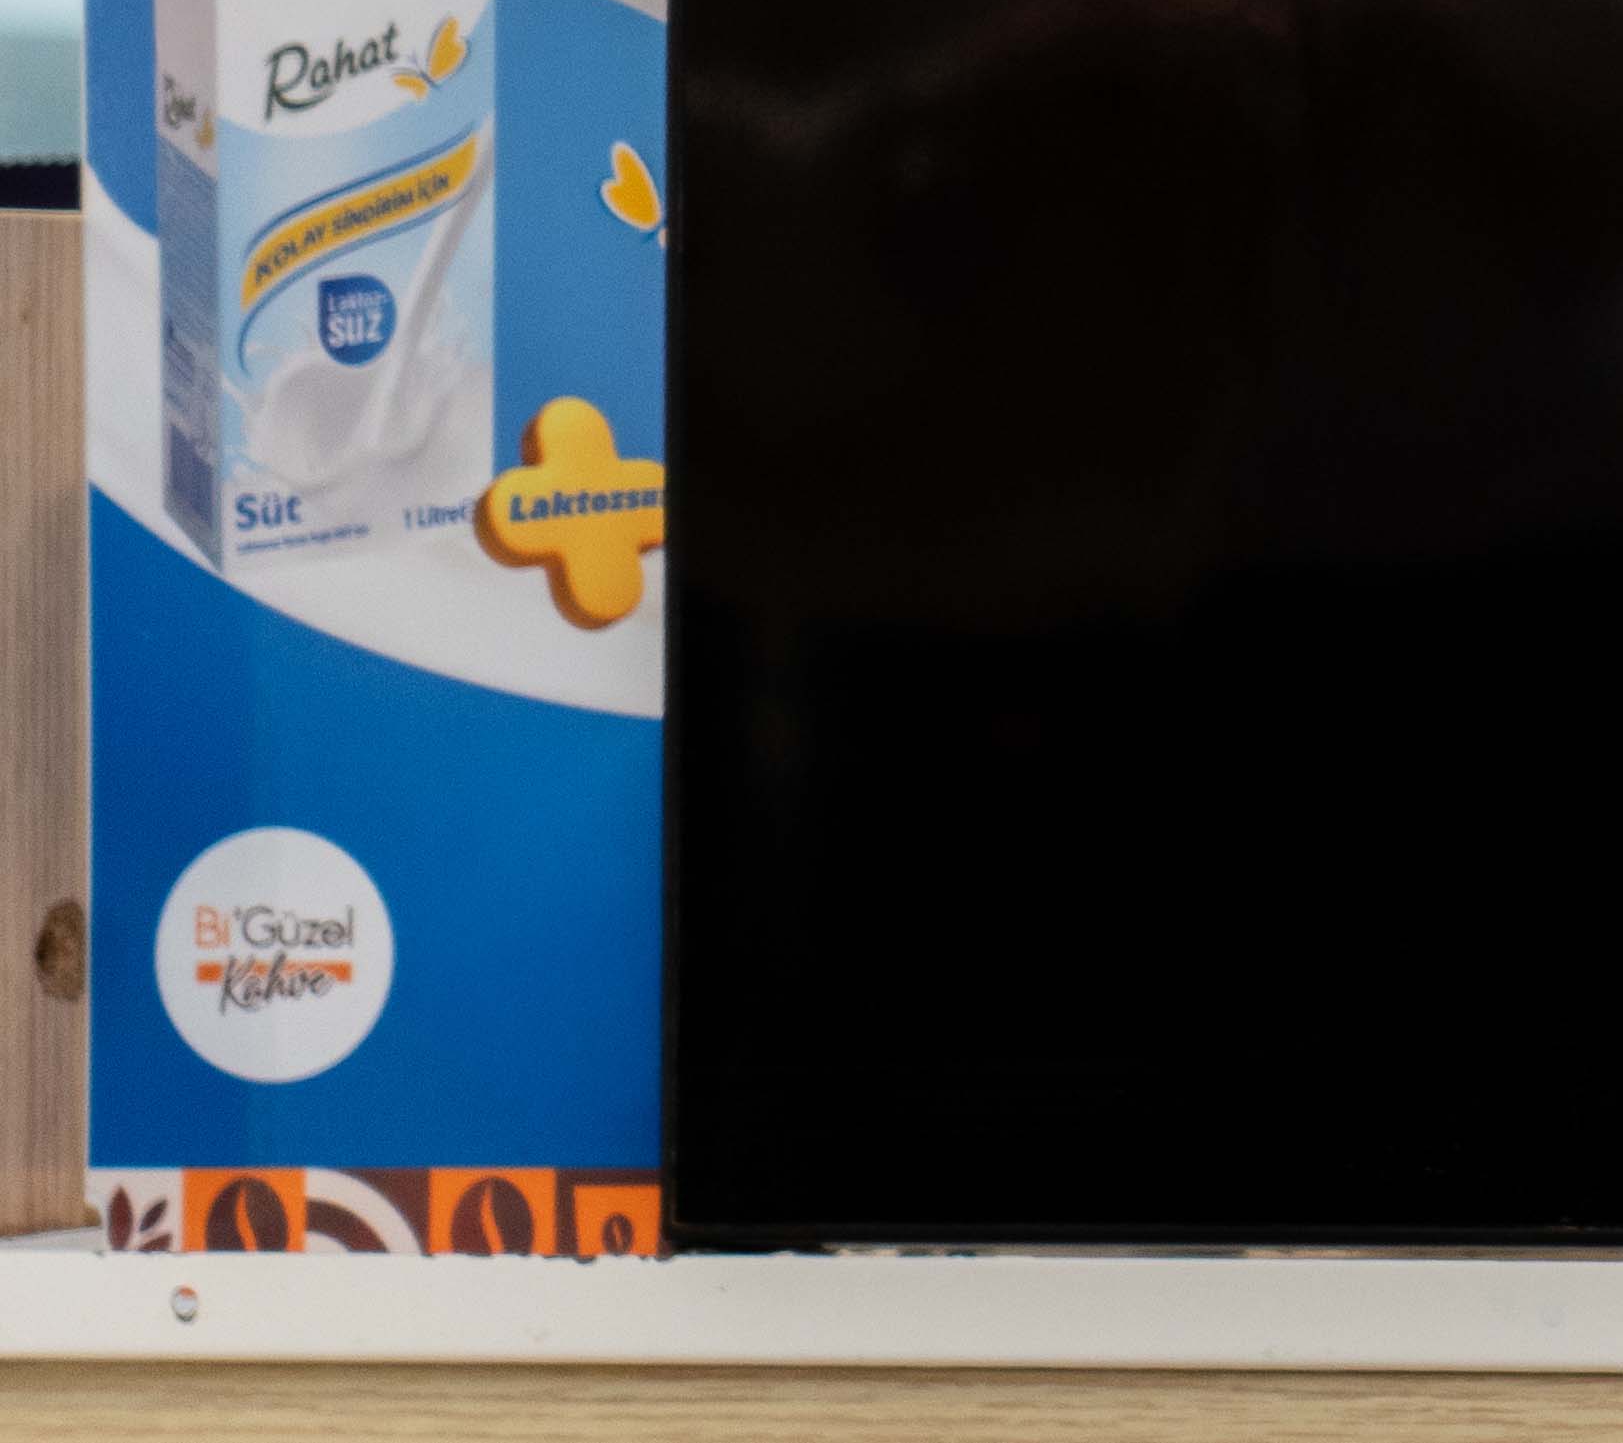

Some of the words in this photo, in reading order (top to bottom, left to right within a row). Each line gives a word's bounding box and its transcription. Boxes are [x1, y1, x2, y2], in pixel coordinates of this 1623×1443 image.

[263, 22, 399, 122] Rahat
[234, 491, 302, 532] Süt
[220, 952, 335, 1015] Kahve
